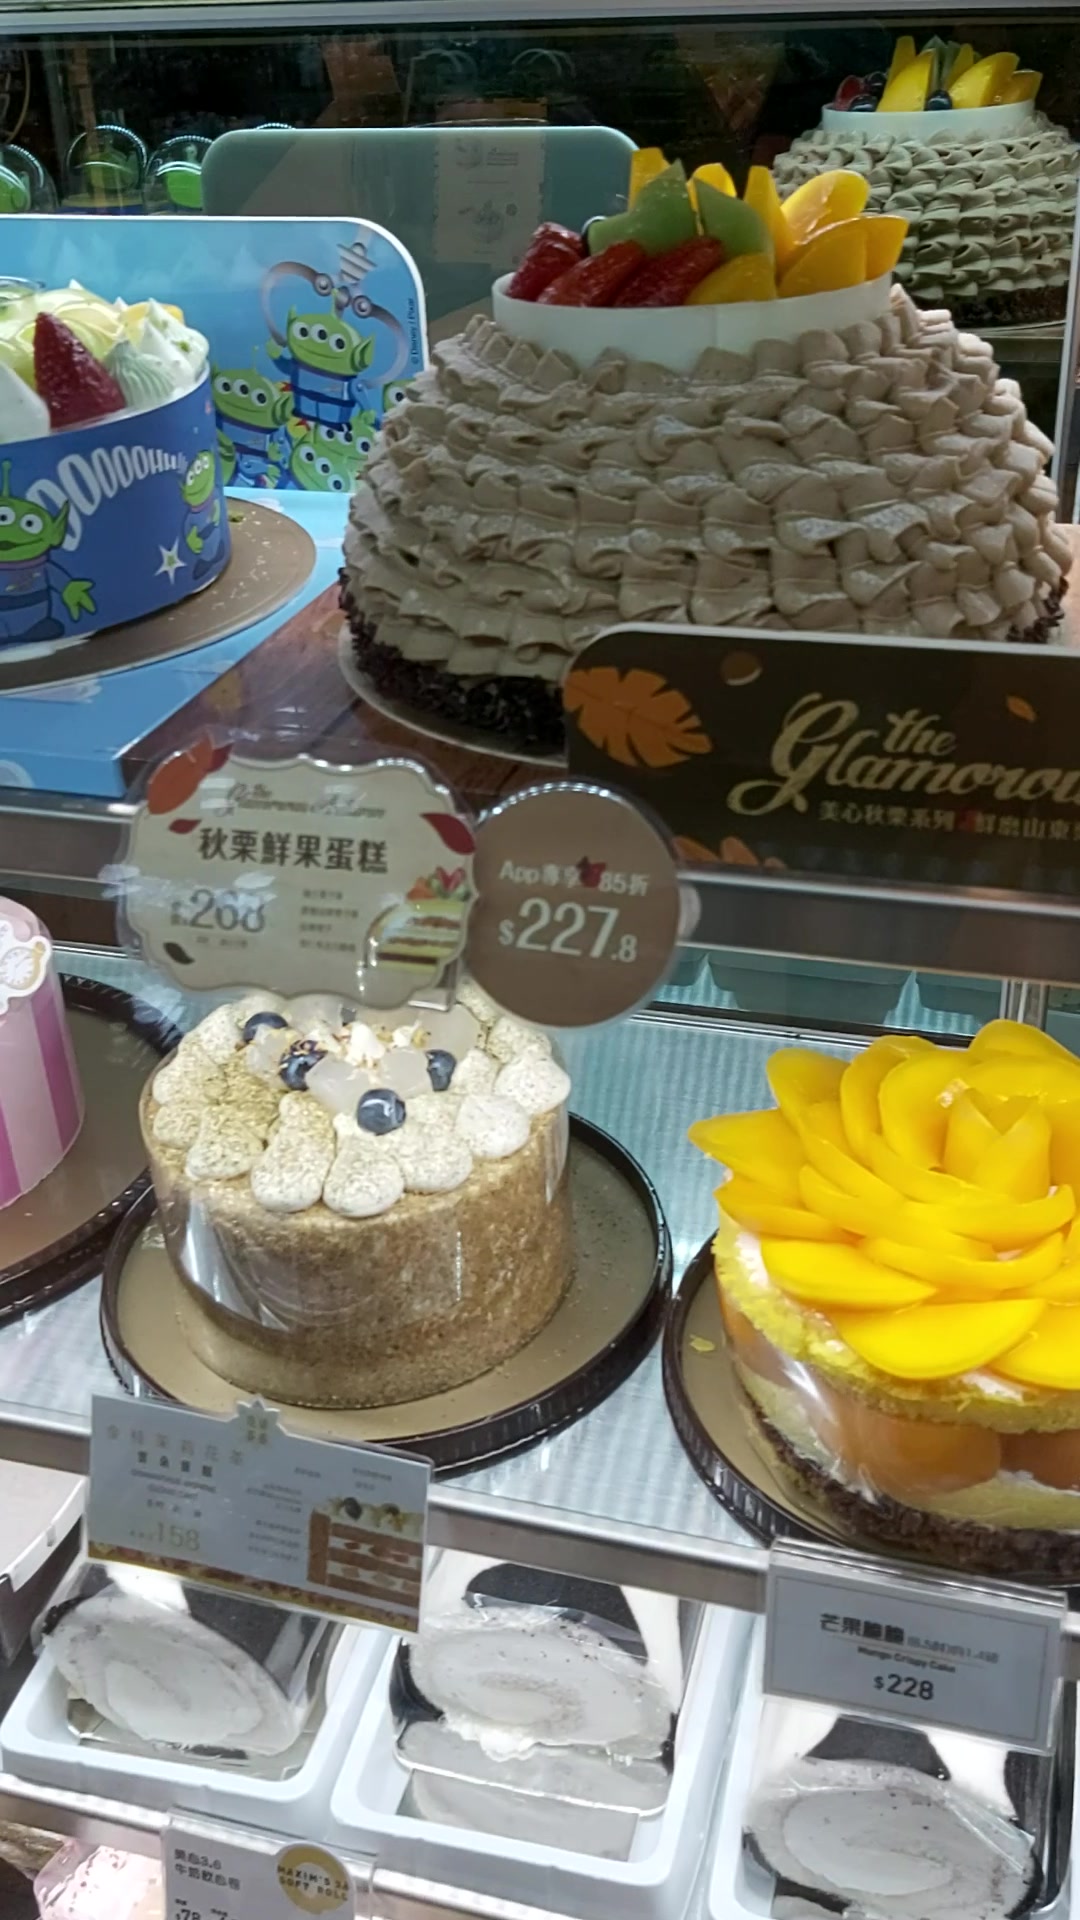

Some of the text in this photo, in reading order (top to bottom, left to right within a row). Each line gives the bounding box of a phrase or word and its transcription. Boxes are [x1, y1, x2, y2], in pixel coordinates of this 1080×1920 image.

[883, 708, 957, 756] the
[199, 827, 388, 874] 秋栗鮮果蛋糕
[498, 897, 638, 962] $227.8
[873, 1673, 934, 1700] $228
[277, 1864, 330, 1886] MAXIM'S
[279, 1875, 309, 1890] SOFT
